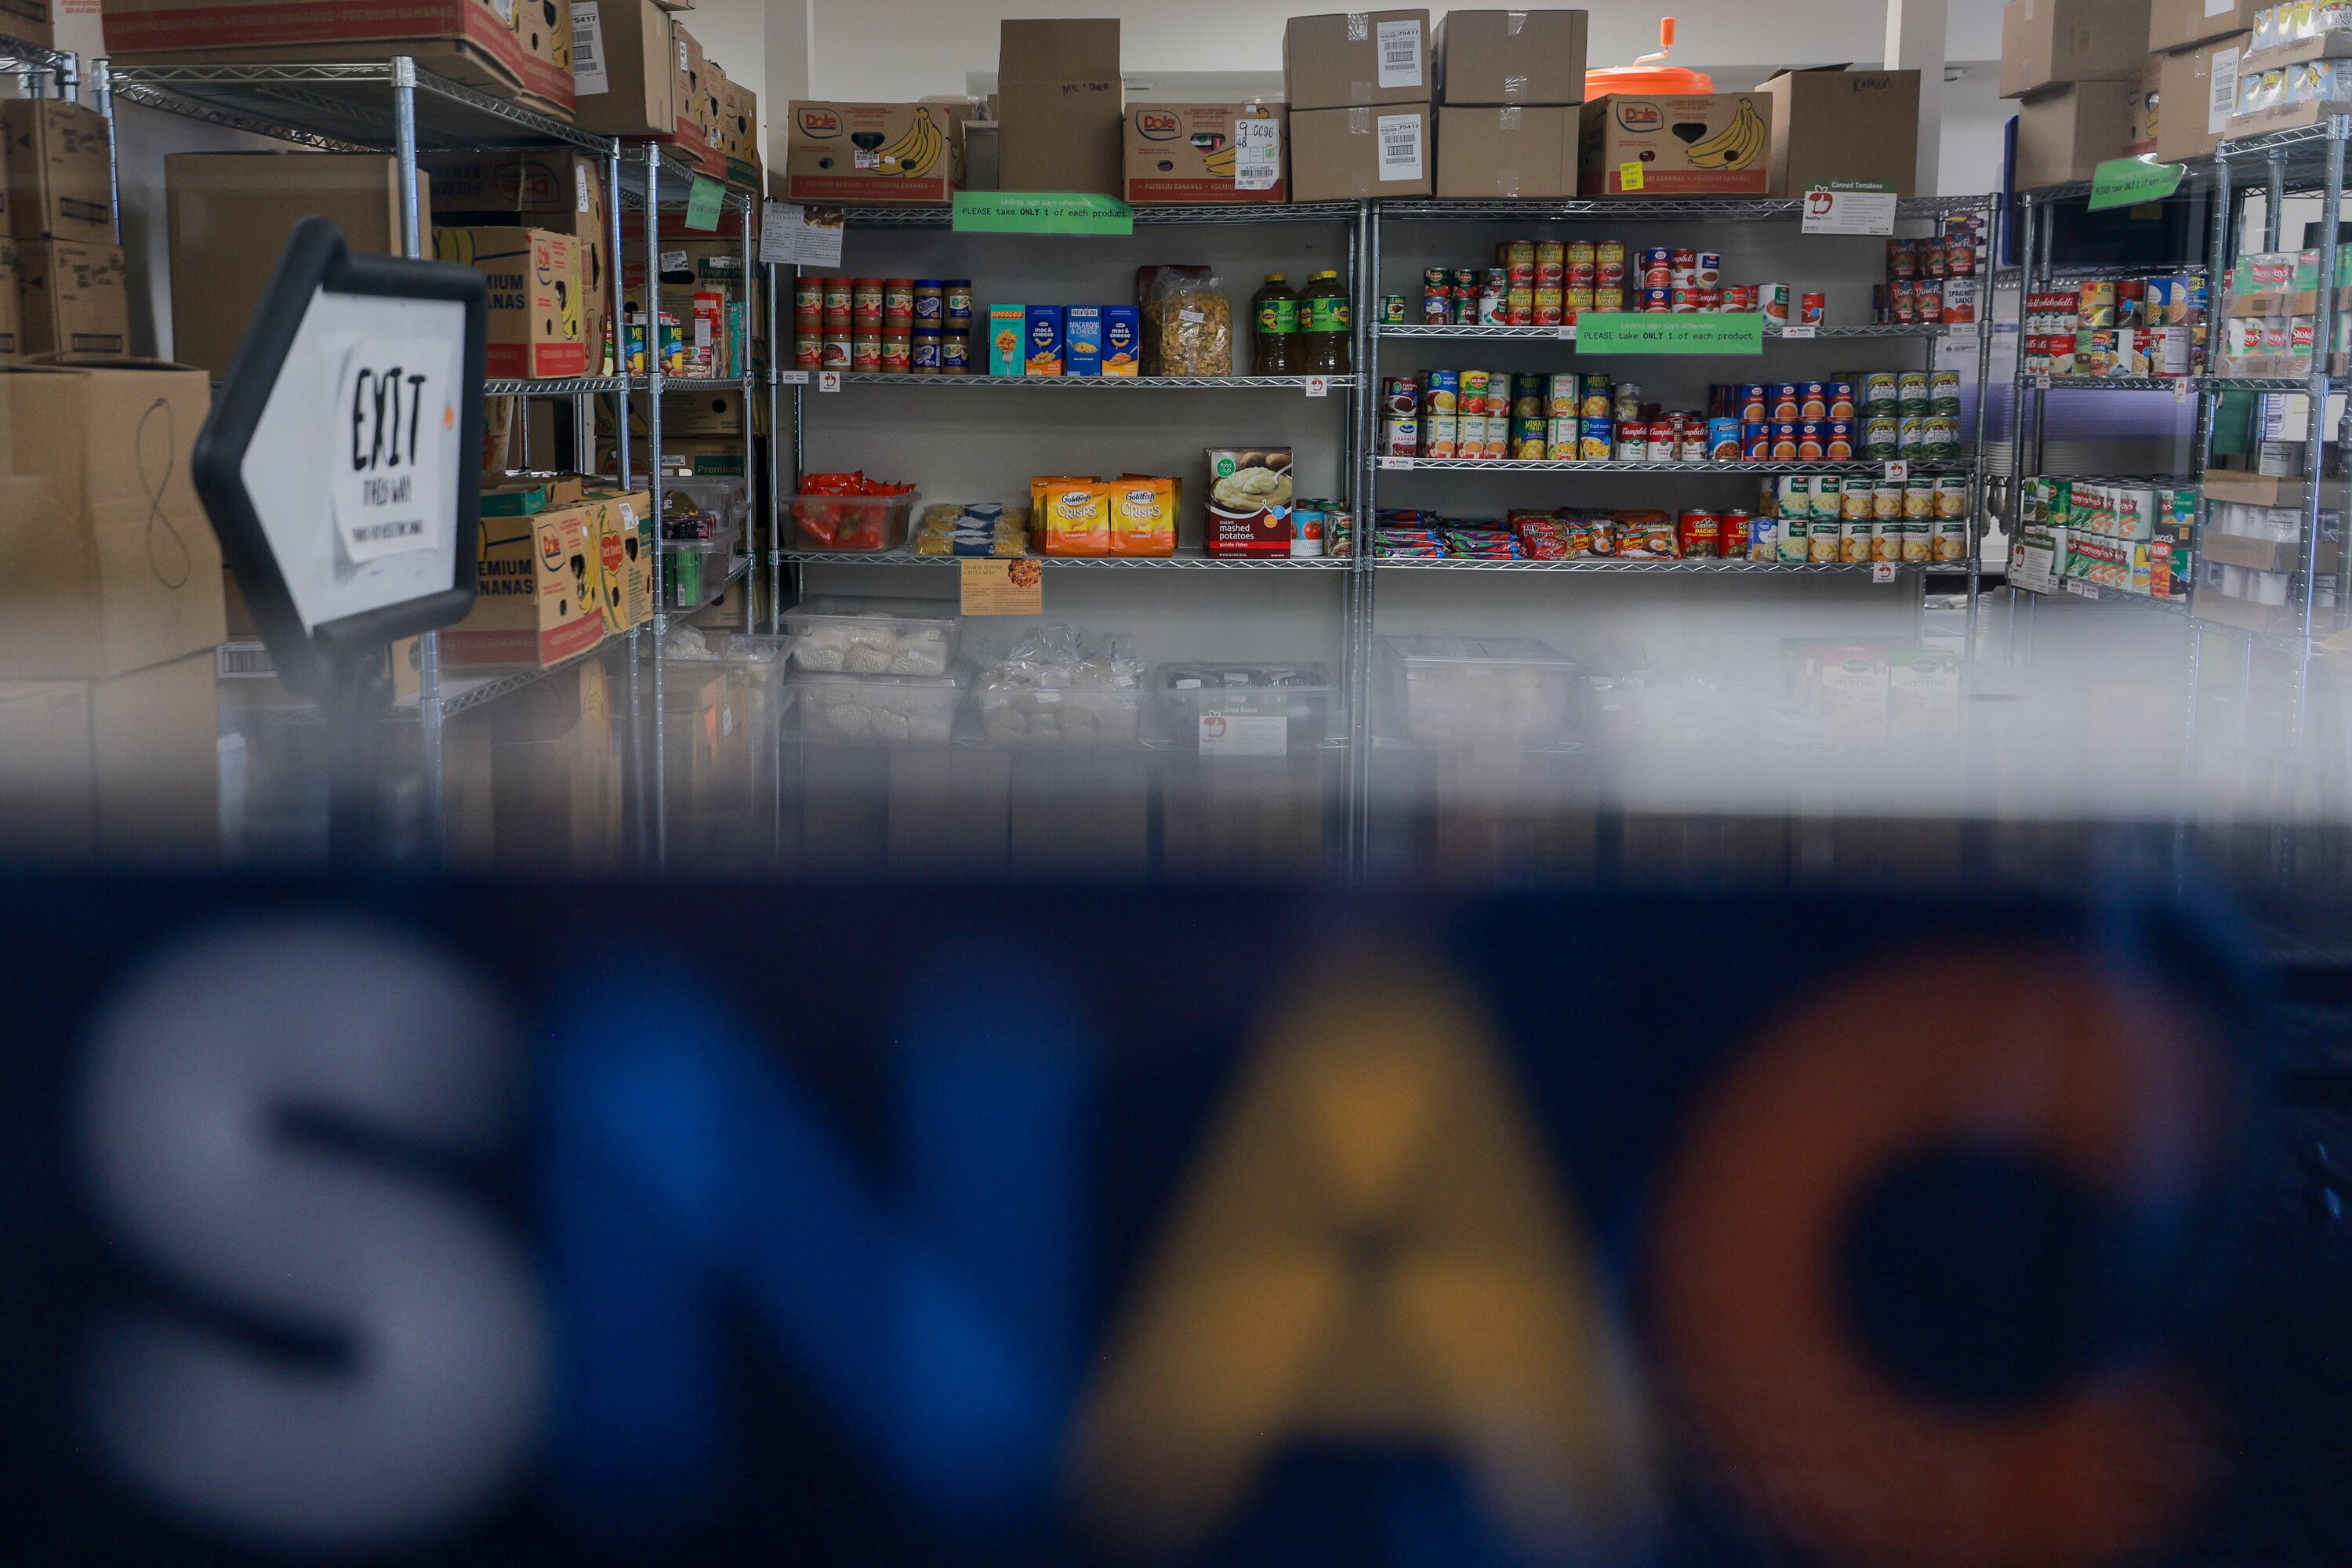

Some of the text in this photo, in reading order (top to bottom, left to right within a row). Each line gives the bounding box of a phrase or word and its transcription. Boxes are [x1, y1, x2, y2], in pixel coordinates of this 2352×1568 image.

[341, 8, 396, 21] PREMIUM
[400, 5, 454, 18] BANANAS
[1853, 76, 1893, 91] Ramen
[1625, 108, 1657, 120] Dole
[806, 114, 836, 128] Dole
[1144, 116, 1175, 129] Dole
[1236, 137, 1247, 147] 48
[1092, 210, 1127, 219] product
[1672, 253, 1693, 263] mpbell's
[486, 275, 524, 289] MIUM
[2190, 278, 2205, 288] SH'S
[1621, 321, 1645, 330] Unless
[1643, 332, 1664, 340] ONLY
[1693, 332, 1713, 340] each
[1718, 332, 1753, 342] product
[353, 366, 427, 471] EXIT
[1621, 426, 1646, 437] Campbe
[1650, 427, 1673, 437] Campbe
[1683, 428, 1707, 437] mpbell's
[698, 465, 741, 474] Premium
[1062, 493, 1091, 504] Goldfish
[1126, 491, 1155, 502] Goldfish
[1058, 504, 1096, 519] CRISPS
[1121, 503, 1160, 519] CRISPS
[1523, 523, 1539, 532] Top
[1220, 532, 1254, 541] potatoes
[478, 560, 532, 576] EMIUM
[478, 579, 533, 596] NANAS
[1832, 679, 1876, 688] STUFFING
[74, 913, 2219, 1568] SNAC
